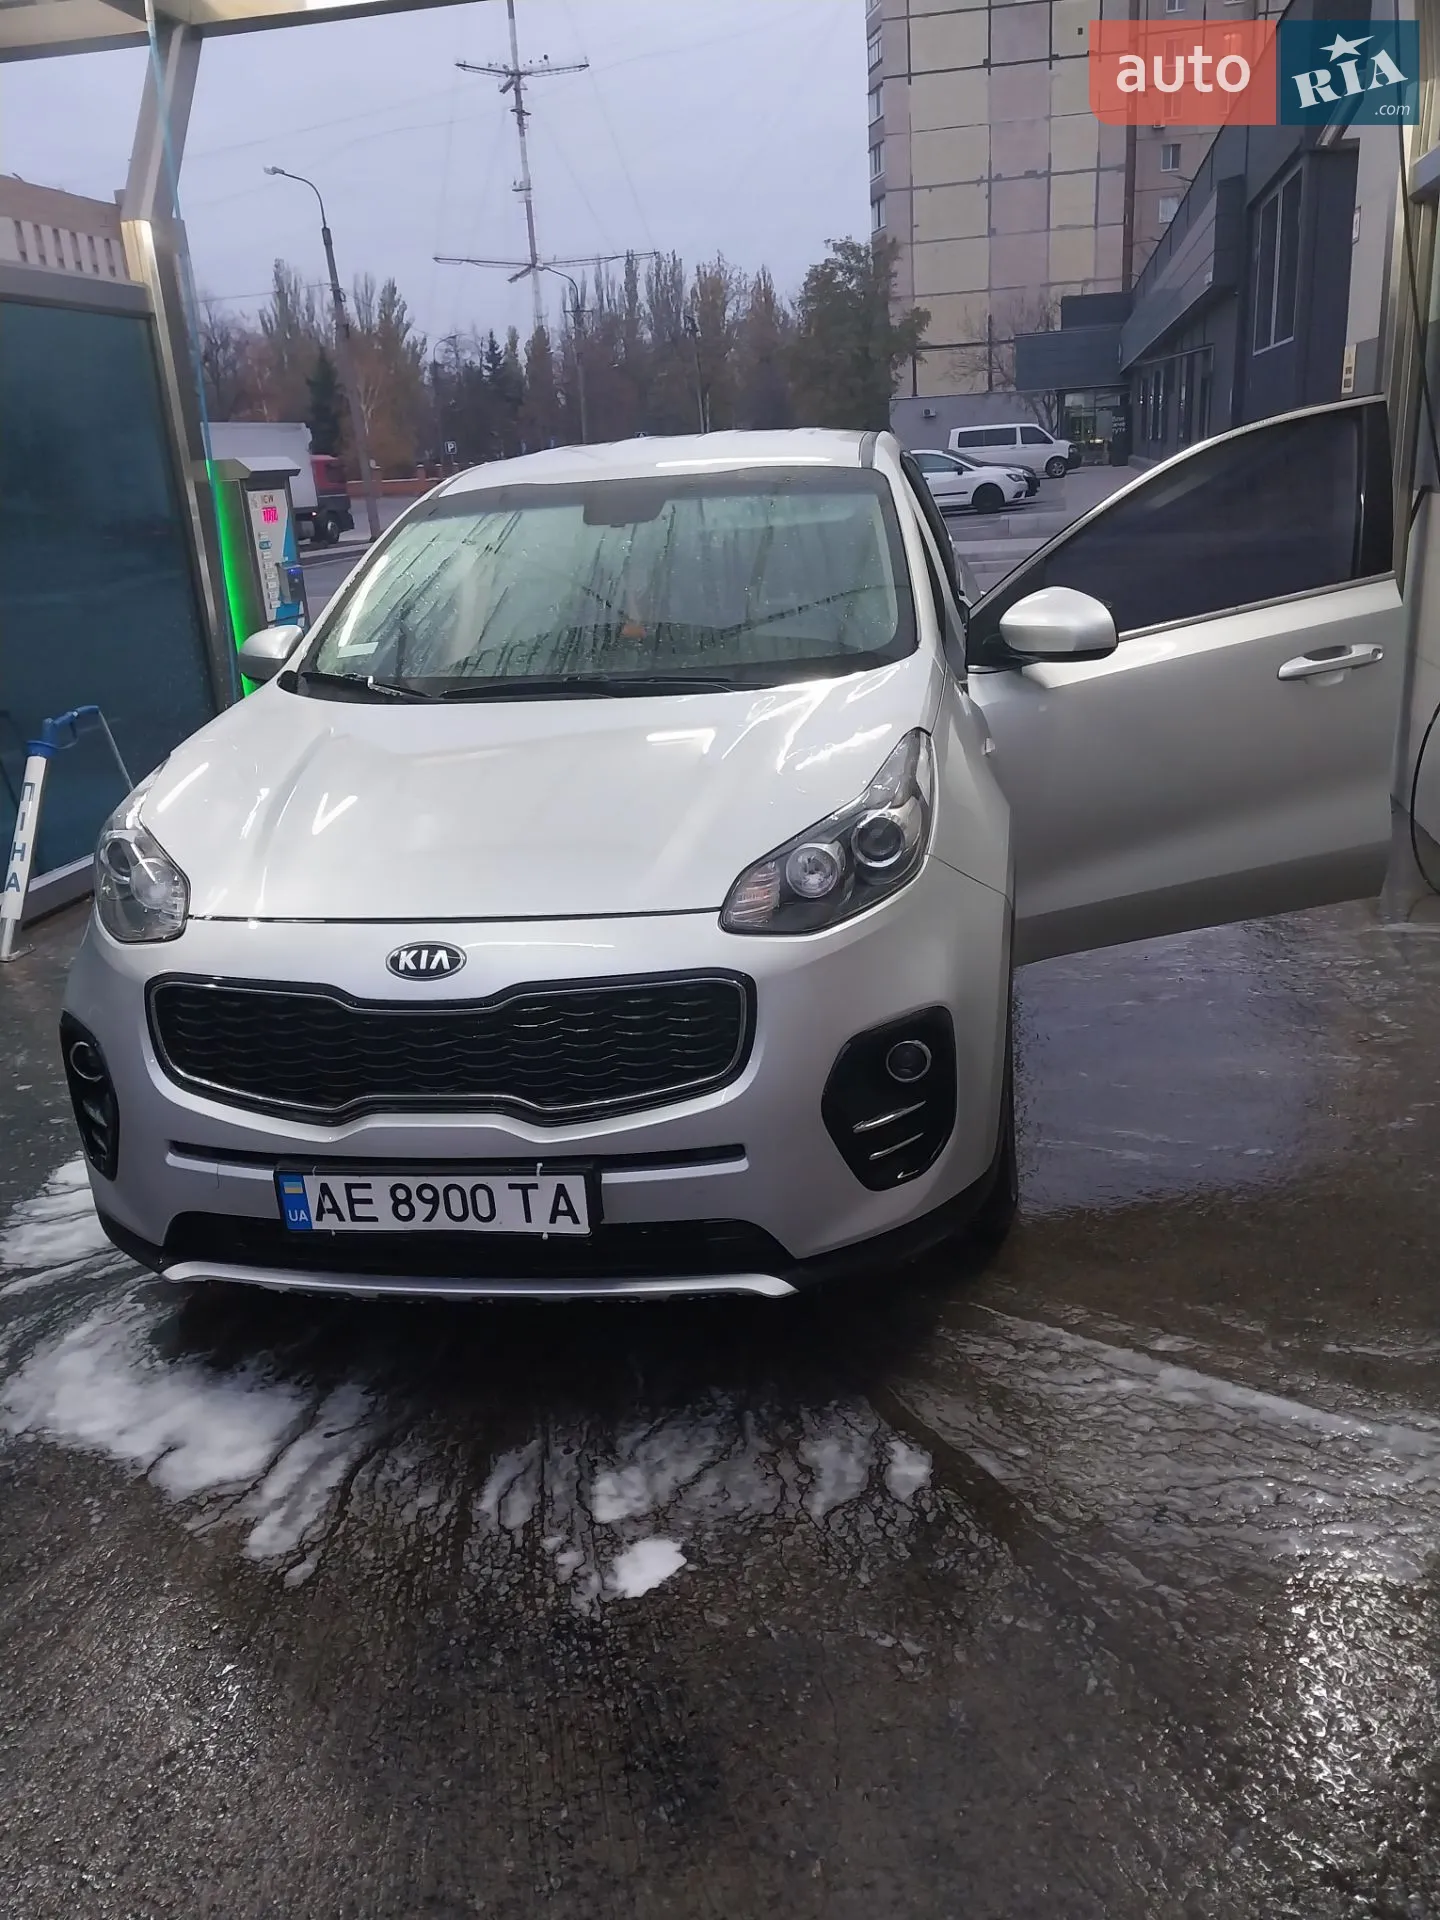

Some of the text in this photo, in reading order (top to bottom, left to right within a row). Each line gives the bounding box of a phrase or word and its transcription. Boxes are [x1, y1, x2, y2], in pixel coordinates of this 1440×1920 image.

[447, 443, 455, 453] P
[398, 949, 450, 970] KIA
[315, 1182, 581, 1225] AE 8900 TA
[288, 1209, 309, 1222] UA
